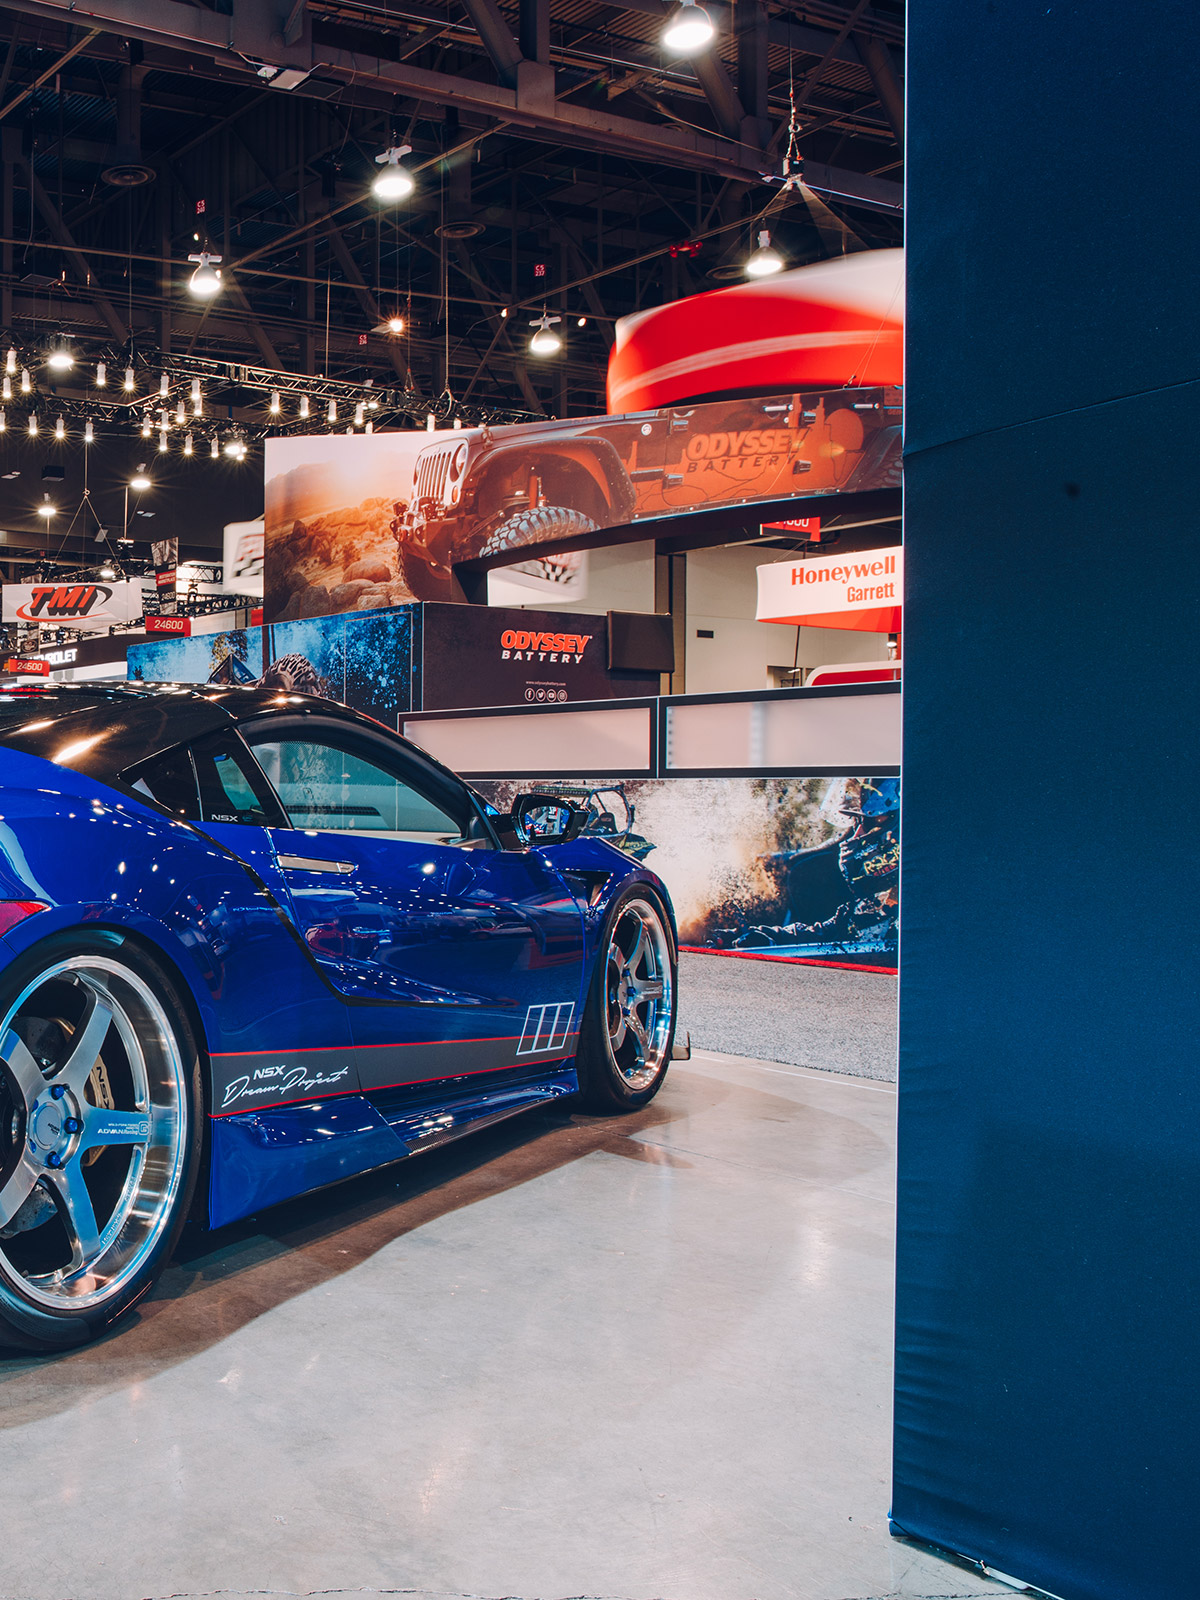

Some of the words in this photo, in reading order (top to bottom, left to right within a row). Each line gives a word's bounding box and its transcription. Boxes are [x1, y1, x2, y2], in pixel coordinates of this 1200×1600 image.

[686, 428, 808, 462] ODYSSEY
[686, 454, 796, 473] BATTERY
[791, 555, 896, 585] Honeywell
[29, 586, 99, 617] TMI
[847, 582, 895, 603] Garrett
[154, 619, 184, 630] 24600
[501, 629, 590, 654] ODYSSEY
[17, 662, 43, 671] 24500
[501, 649, 584, 664] BATTERY
[211, 814, 239, 823] NSX
[253, 1065, 286, 1080] NSX
[221, 1075, 279, 1108] Dream
[279, 1066, 349, 1095] Project
